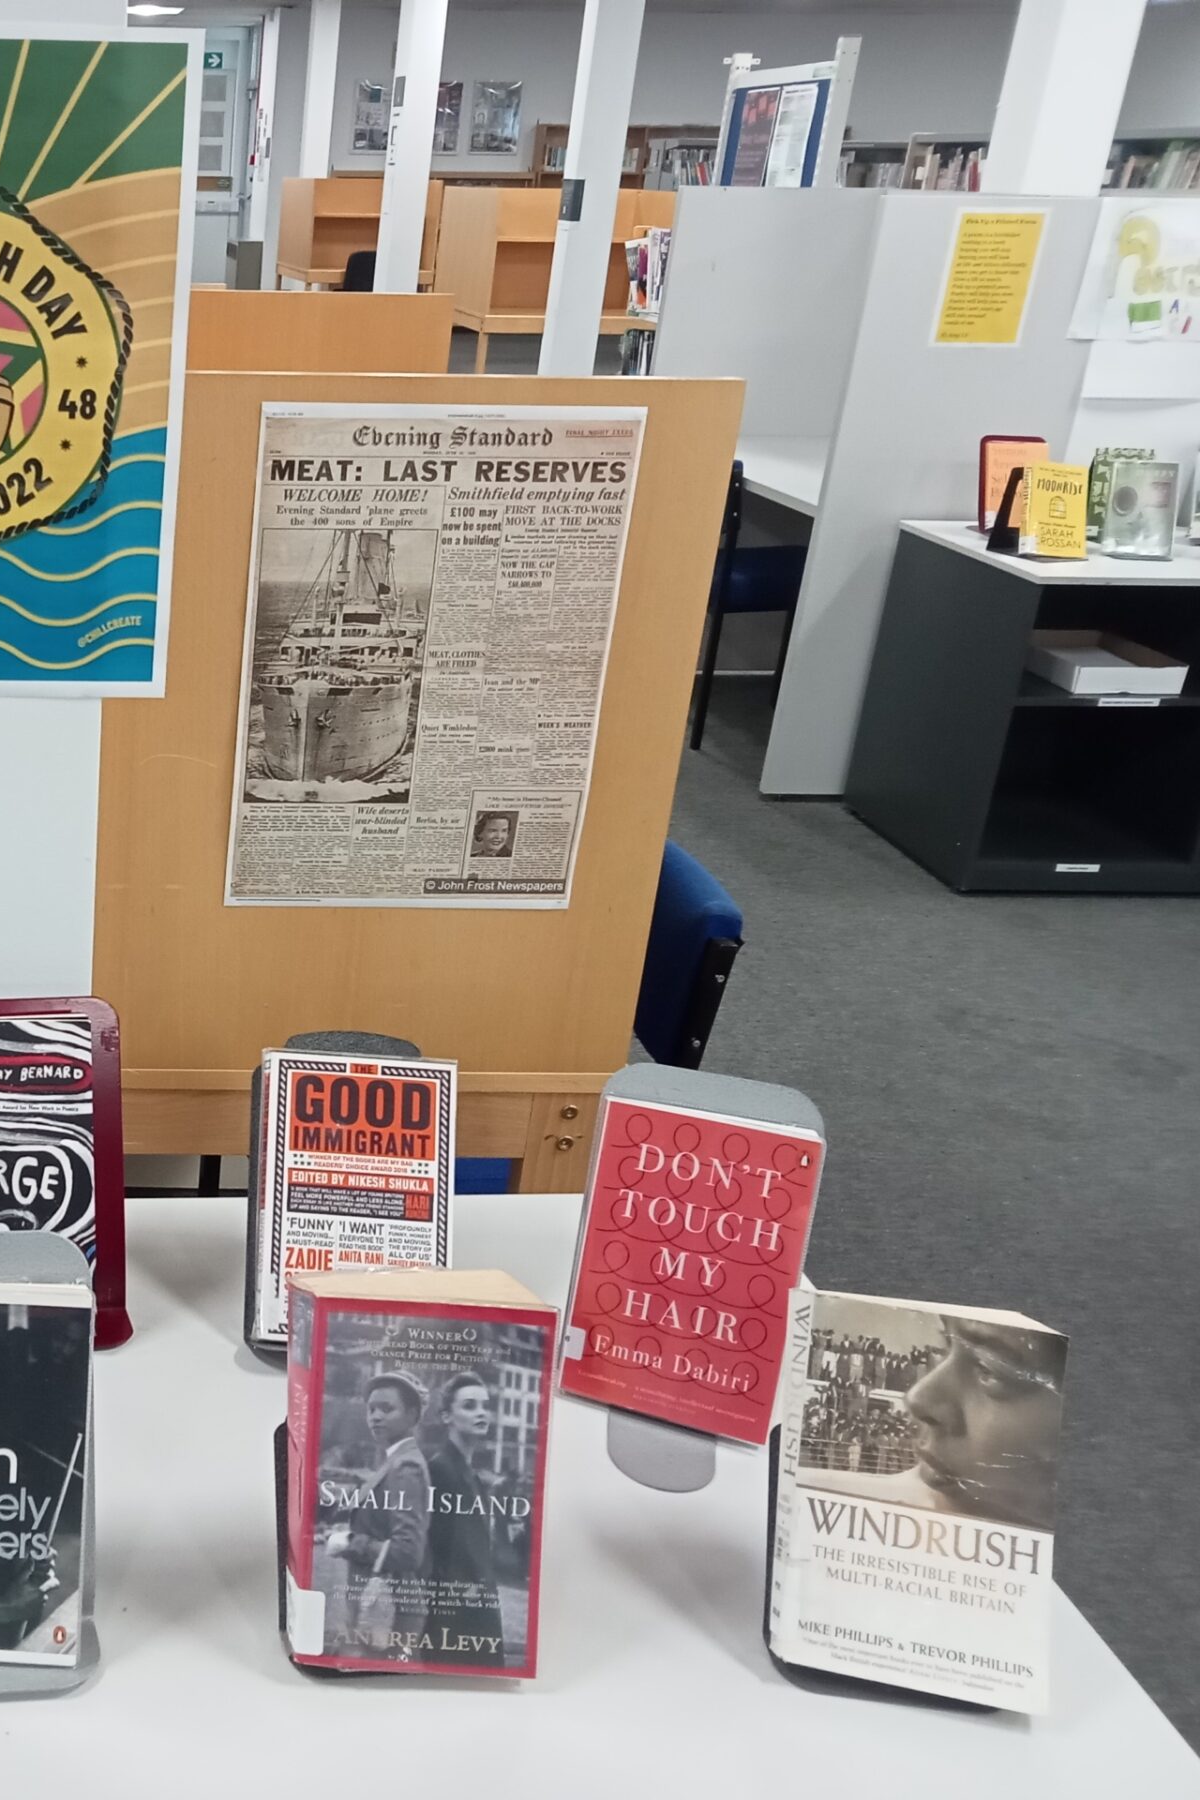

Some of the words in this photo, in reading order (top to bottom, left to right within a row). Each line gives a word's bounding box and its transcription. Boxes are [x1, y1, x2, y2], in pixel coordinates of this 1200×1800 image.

[20, 265, 88, 340] DAY
[58, 389, 97, 420] 48
[353, 425, 441, 449] Evening
[450, 425, 552, 449] Standard
[270, 460, 363, 482] MEAT:
[383, 461, 457, 482] LAST
[475, 460, 626, 483] RESERVES
[284, 489, 362, 502] WELCOME
[372, 489, 428, 502] HOME!
[448, 487, 525, 500] Smithfield
[527, 490, 595, 501] emptying
[598, 488, 625, 500] fast
[276, 505, 314, 515] Evening
[320, 506, 361, 515] Standard
[400, 508, 427, 516] greets
[380, 519, 413, 527] Empire
[505, 505, 536, 514] FIRST
[543, 505, 623, 515] BACK-TO-WORK
[505, 517, 535, 526] MOVE
[541, 517, 555, 526] AT
[560, 517, 582, 526] THE
[587, 517, 621, 526] DOCKS
[426, 881, 436, 891] ©
[438, 881, 462, 891] John
[466, 881, 494, 891] Frost
[498, 881, 563, 893] Newspapers
[20, 1065, 83, 1081] BERNARD
[354, 1064, 375, 1074] THE
[295, 1074, 431, 1131] GOOD
[294, 1127, 430, 1158] IMMIGRANT
[292, 1171, 328, 1184] EDITED
[332, 1173, 345, 1185] BY
[348, 1175, 385, 1188] NIKESH
[388, 1178, 428, 1191] SHUKLA
[634, 1142, 781, 1199] DON'T
[618, 1188, 782, 1252] TOUCH
[285, 1247, 333, 1271] ZADIE
[655, 1247, 725, 1287] MY
[621, 1289, 739, 1344] HAIR
[408, 1328, 462, 1342] WINNER
[594, 1334, 662, 1369] Emma
[673, 1355, 750, 1392] Dabiri
[319, 1480, 412, 1510] SMALL
[427, 1486, 531, 1517] ISLAND
[806, 1497, 1040, 1576] WINDRUSH
[813, 1545, 844, 1564] THE
[850, 1552, 957, 1584] IRRESISTIBLE
[963, 1570, 997, 1591] RISE
[1004, 1579, 1027, 1598] OF
[825, 1566, 942, 1600] MULTI-RACIAL
[949, 1589, 1016, 1615] BRITAIN
[441, 1627, 501, 1654] LEVY
[798, 1620, 830, 1636] MIKE
[835, 1625, 893, 1648] PHILLIPS
[898, 1642, 904, 1651] &
[910, 1641, 967, 1665] TREVOR
[971, 1653, 1034, 1678] PHILLIPS
